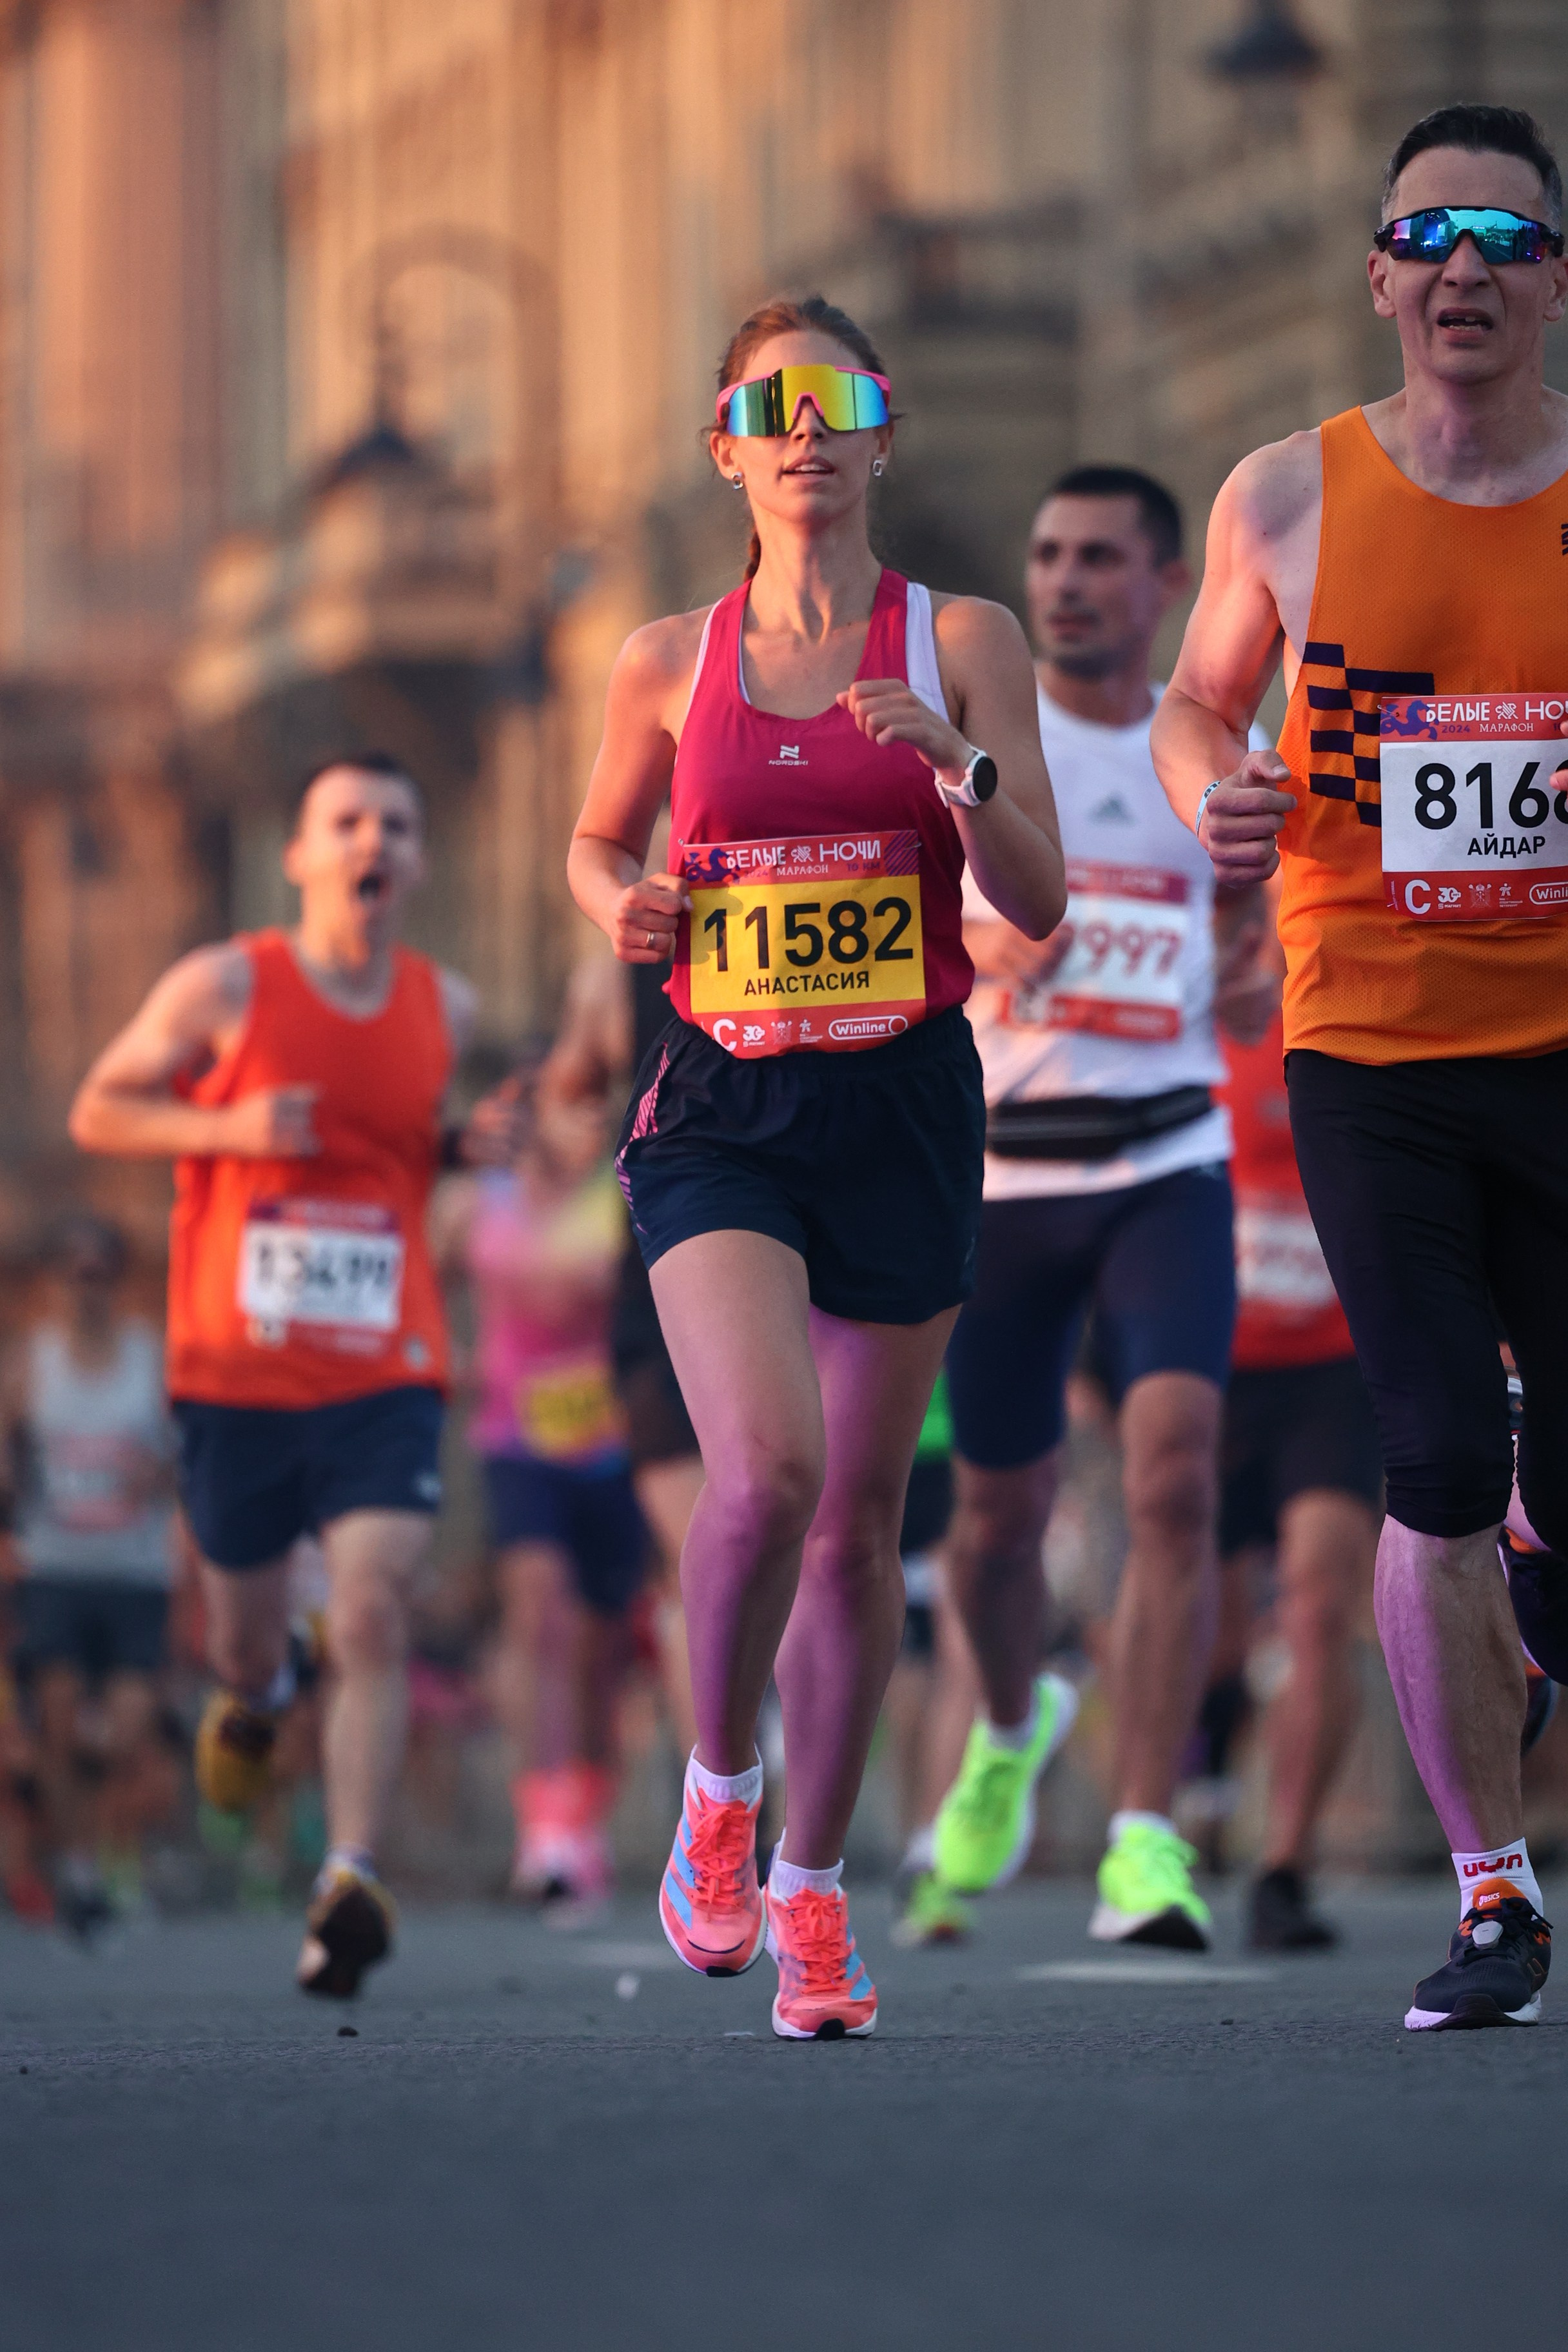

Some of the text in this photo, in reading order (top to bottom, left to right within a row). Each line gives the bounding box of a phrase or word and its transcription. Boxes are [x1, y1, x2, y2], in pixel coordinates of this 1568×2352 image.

[1426, 701, 1491, 723] БЕЛЫЕ
[1442, 725, 1471, 734] 2024
[1479, 723, 1534, 732] МАРАФОН
[1415, 760, 1568, 830] 816
[725, 839, 881, 870] БЕЛЫЕ НОЧИ
[1467, 833, 1546, 859] АЙДАР
[776, 864, 829, 876] МАРАФОН
[704, 897, 914, 972] 11582
[744, 971, 870, 996] АНАСТАСИЯ
[836, 1023, 887, 1036] Winline
